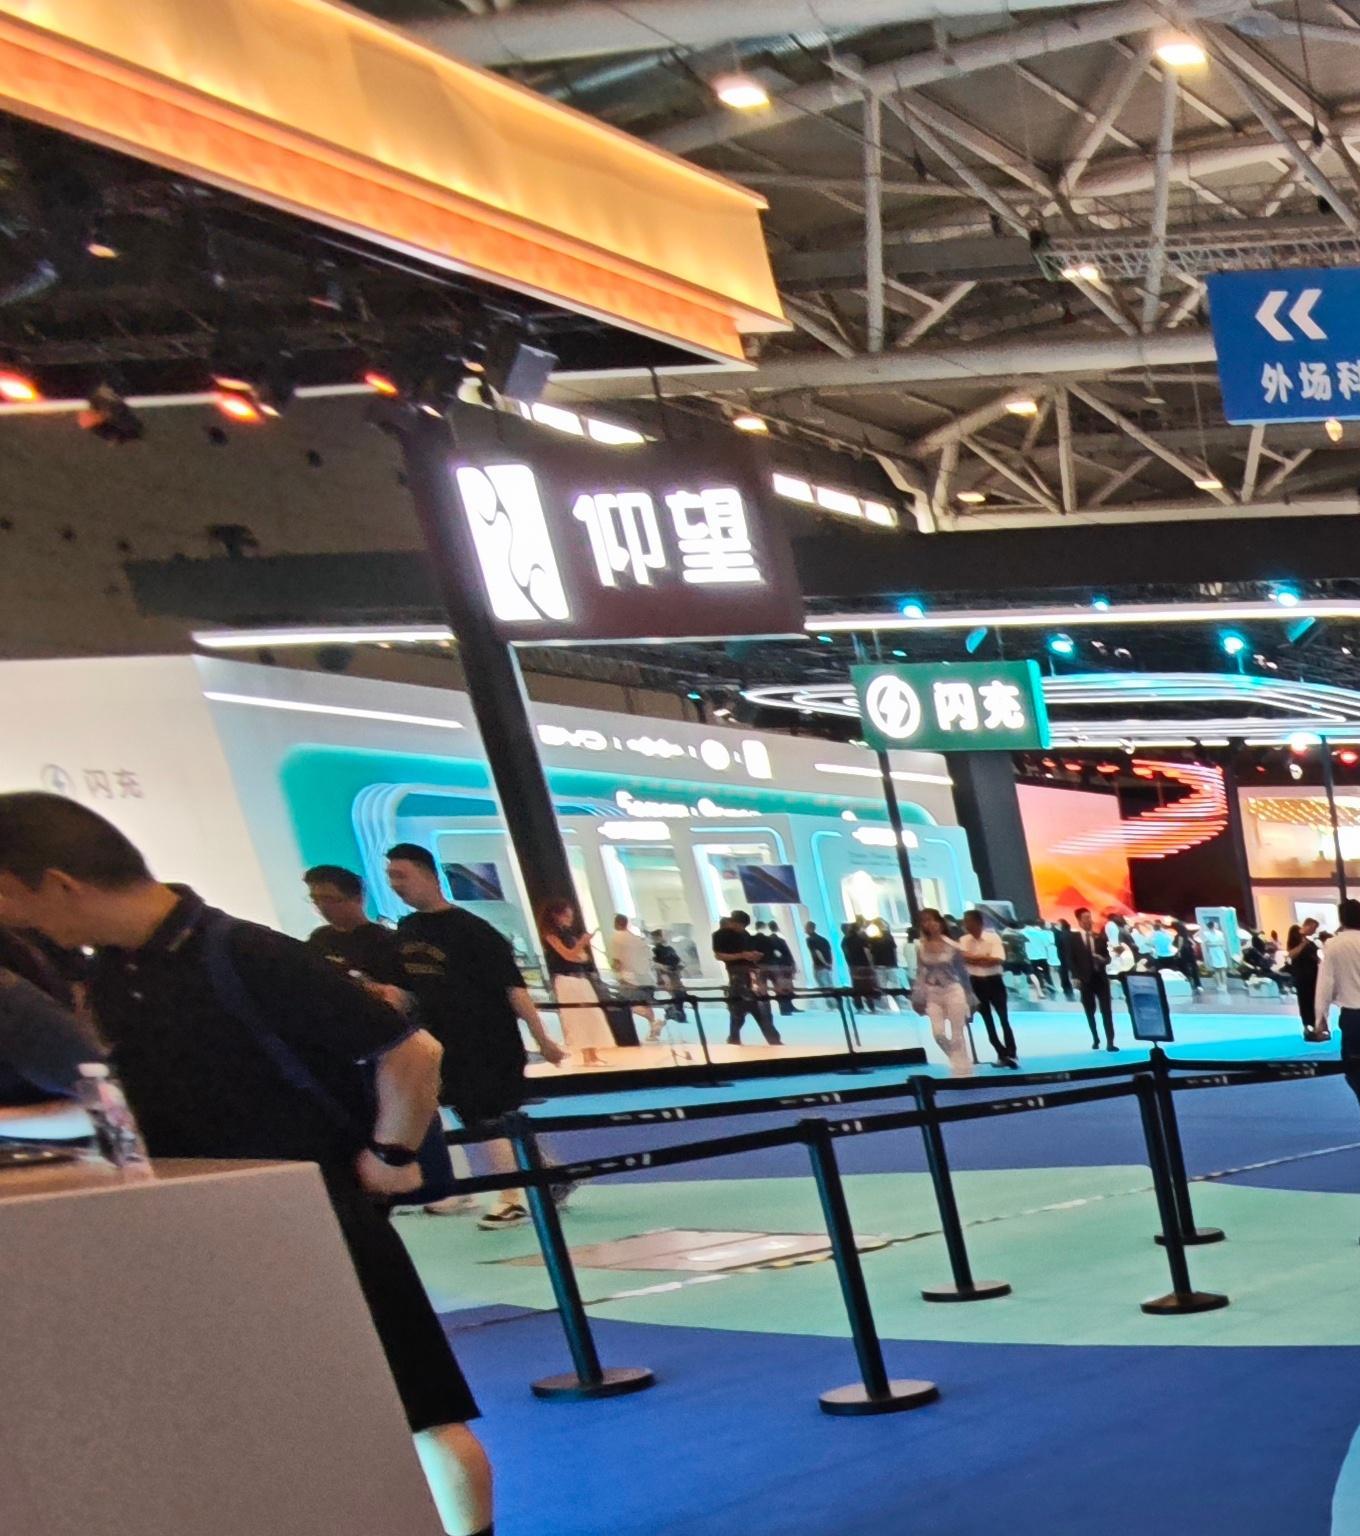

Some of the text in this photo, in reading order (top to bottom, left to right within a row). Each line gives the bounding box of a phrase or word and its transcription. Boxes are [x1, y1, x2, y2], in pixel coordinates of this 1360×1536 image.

[572, 487, 763, 588] 仰望
[932, 680, 1026, 731] 闪充
[82, 768, 145, 799] 闪充
